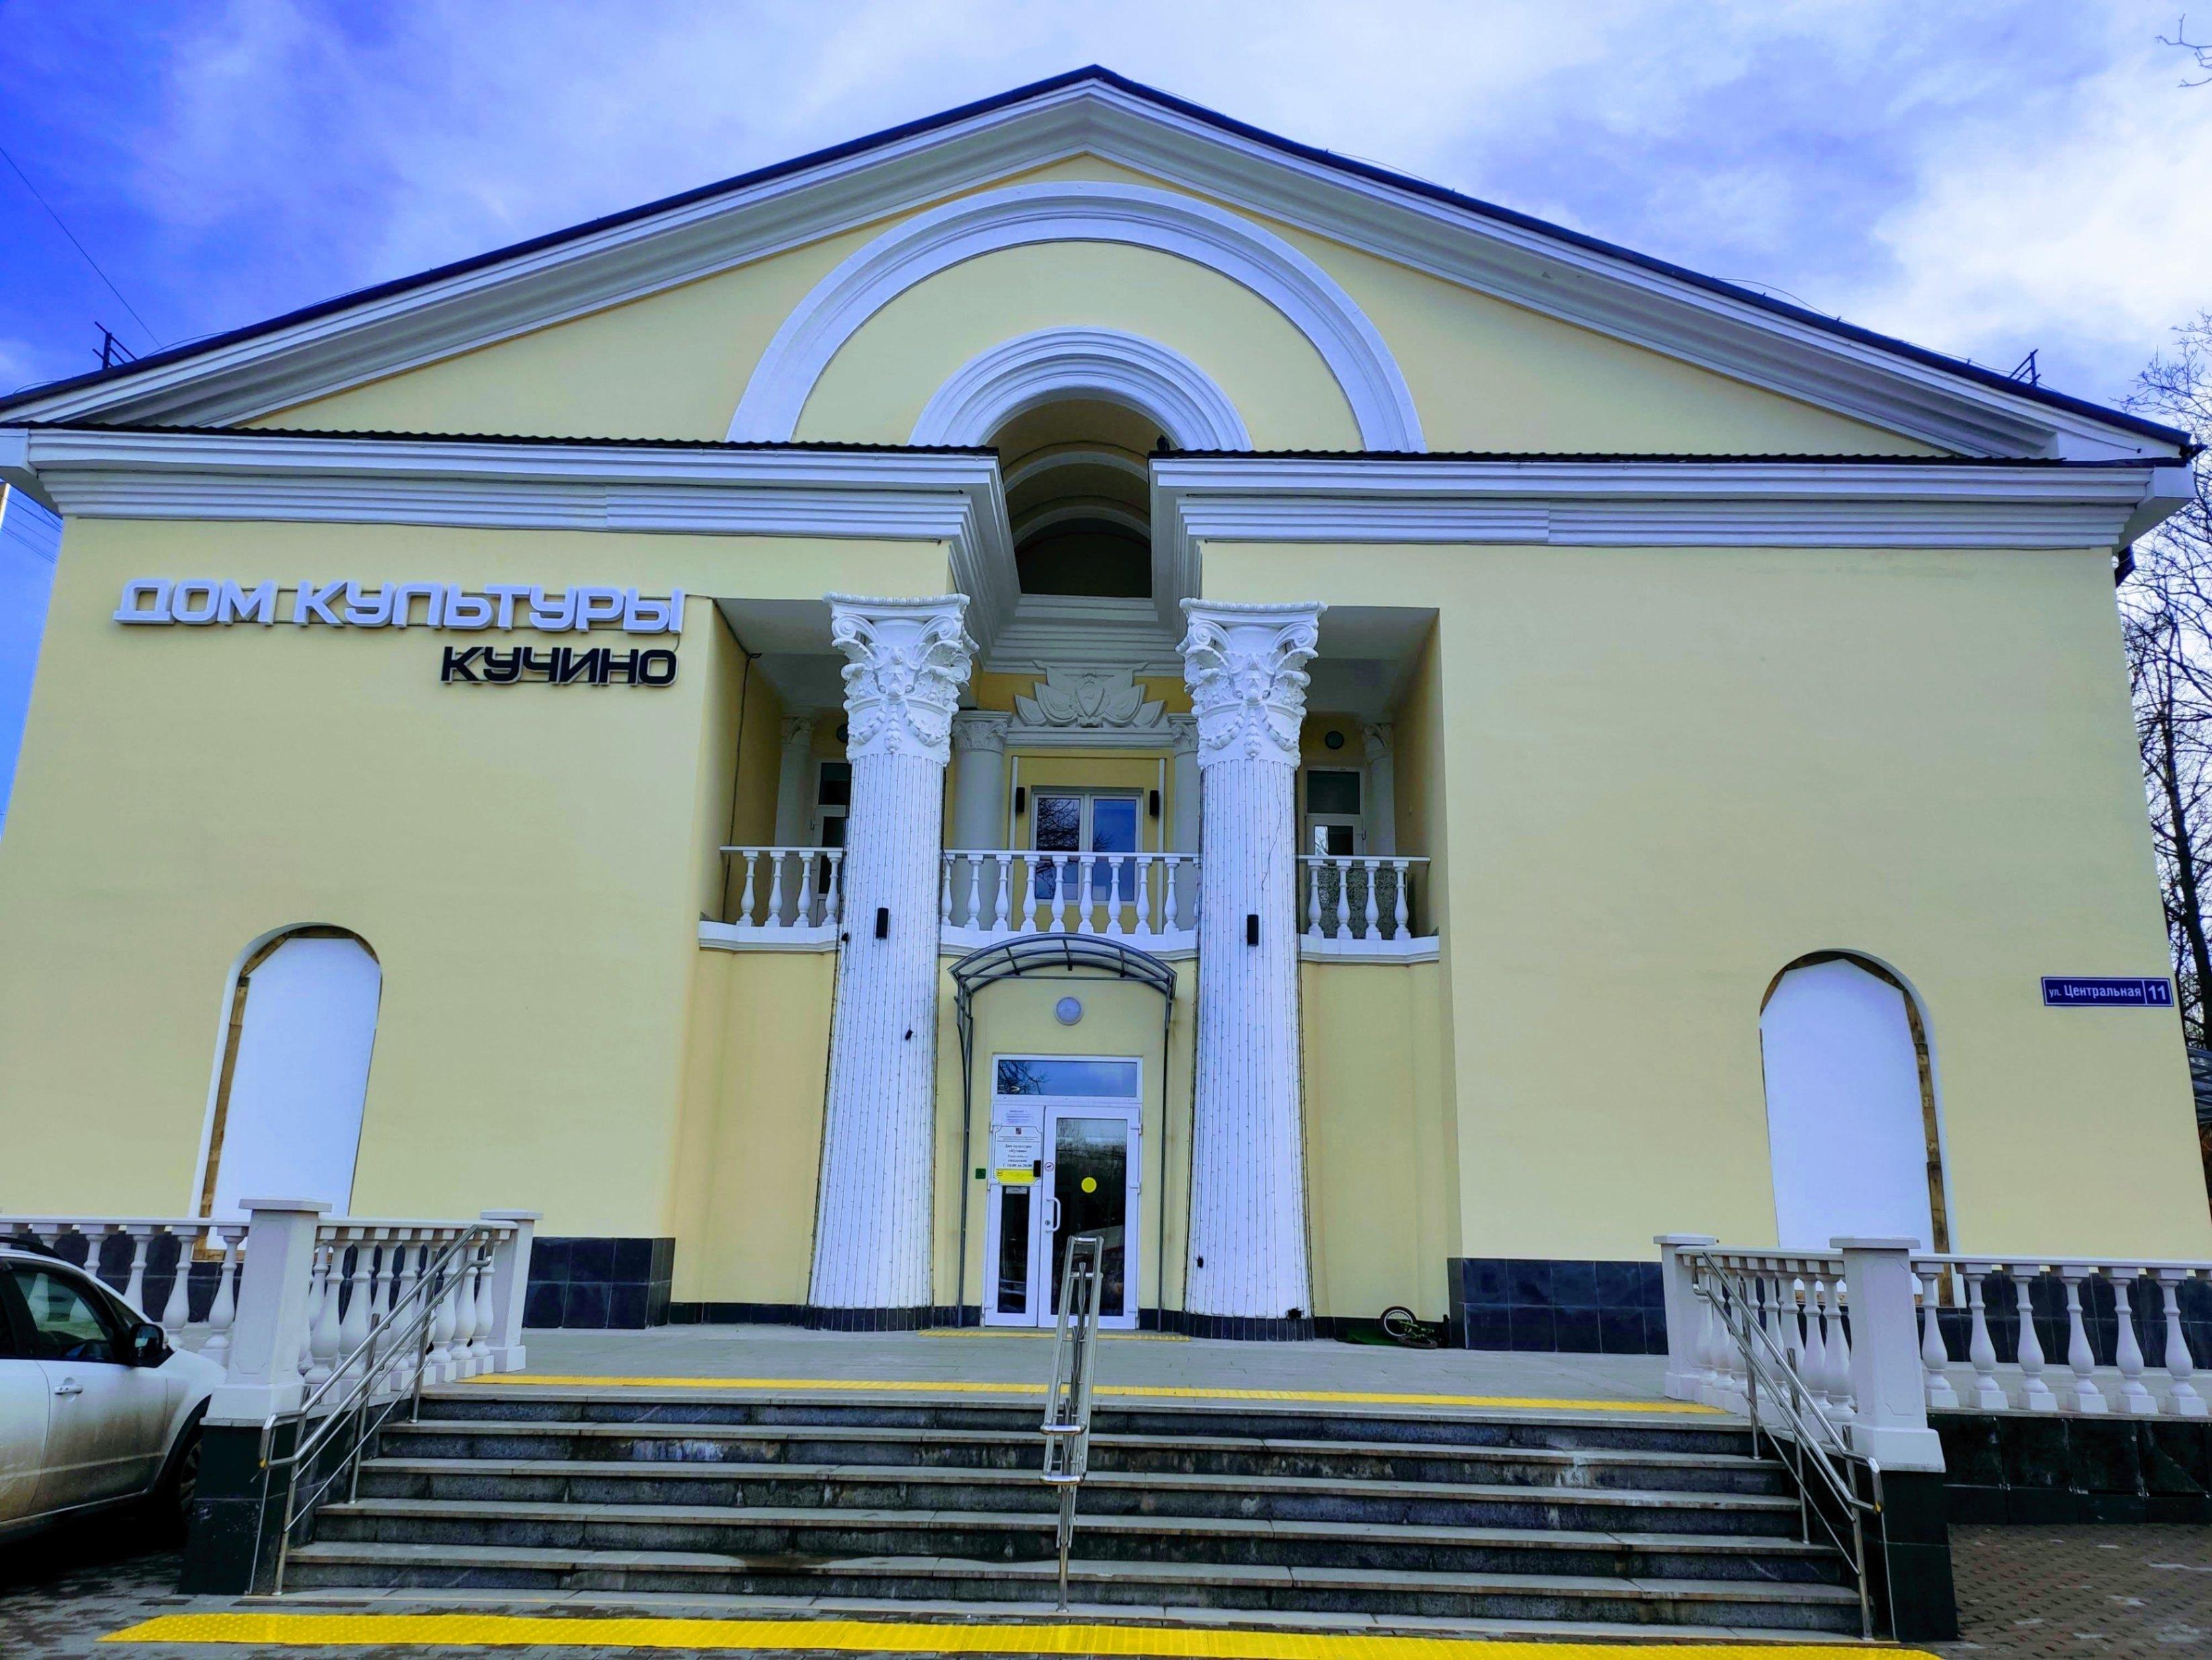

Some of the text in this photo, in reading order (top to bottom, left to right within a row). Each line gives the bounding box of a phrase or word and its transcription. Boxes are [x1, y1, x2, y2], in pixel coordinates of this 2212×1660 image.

[113, 578, 686, 635] ДОМ КУЛЬТУРЫ
[440, 645, 679, 686] КУЧИНО
[2049, 984, 2166, 1000] ул. Центральная 11
